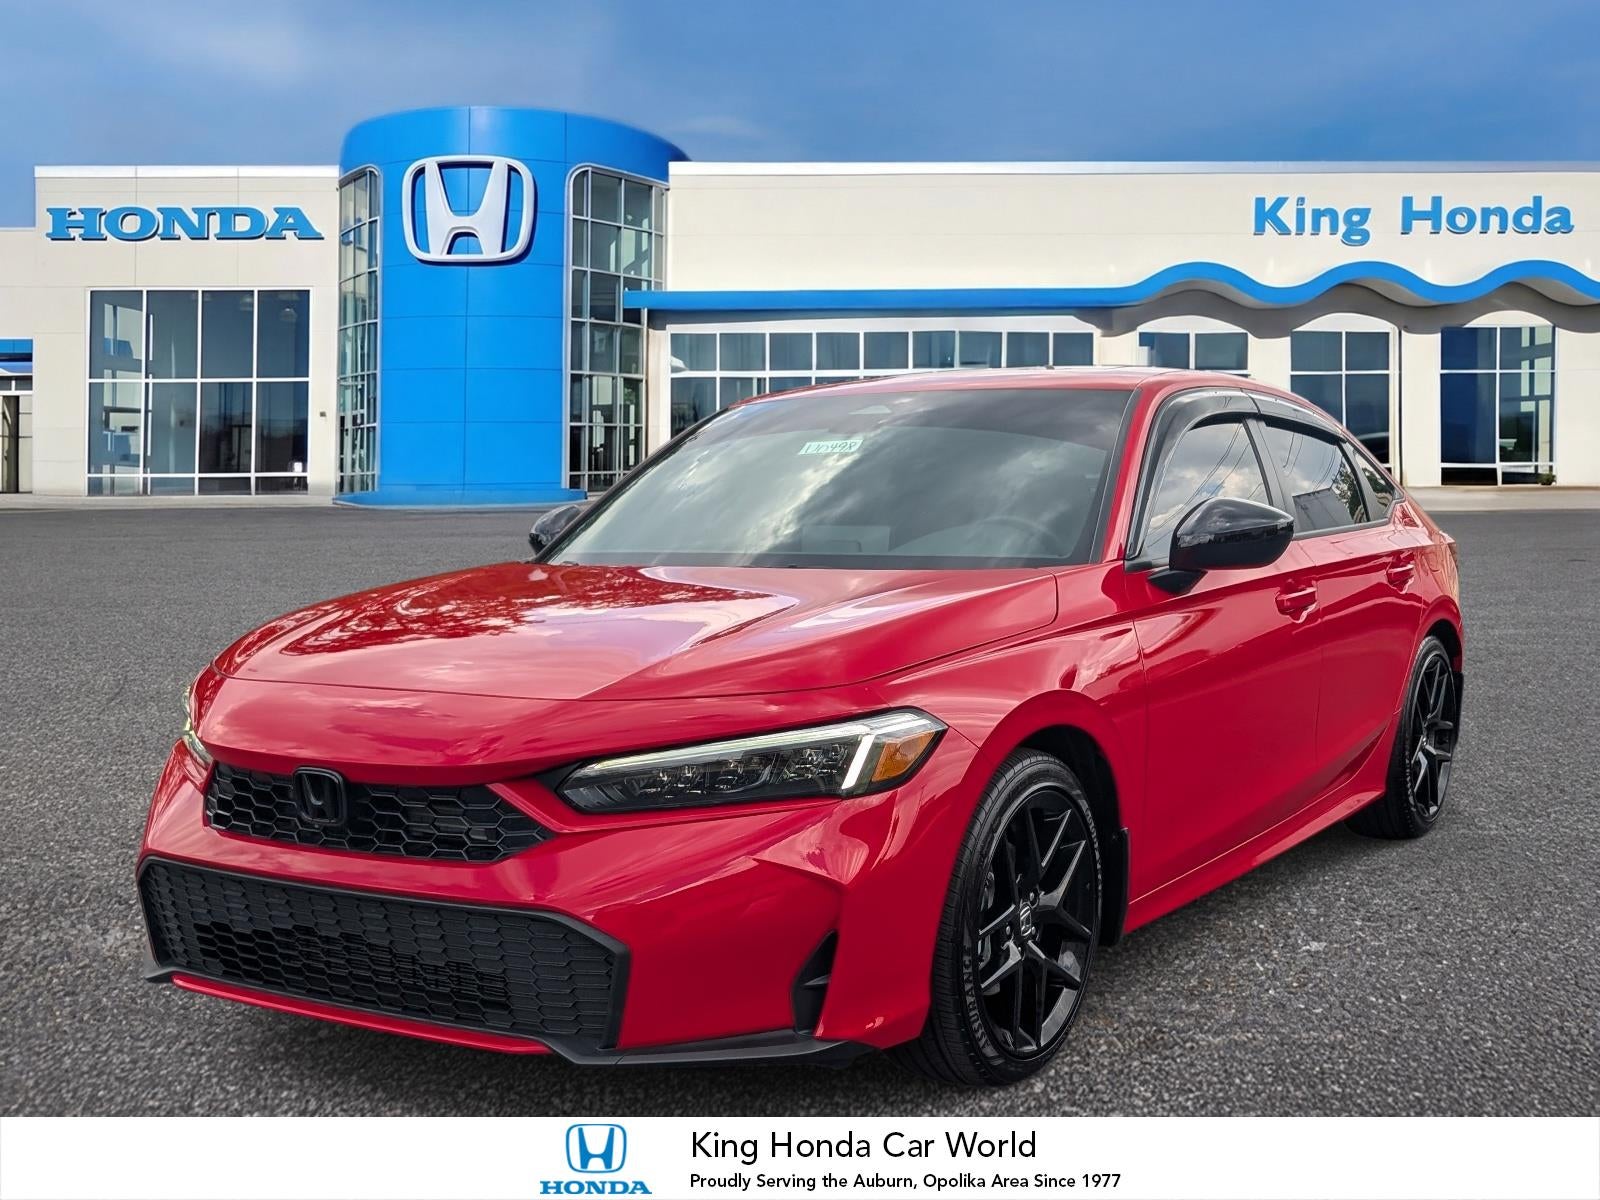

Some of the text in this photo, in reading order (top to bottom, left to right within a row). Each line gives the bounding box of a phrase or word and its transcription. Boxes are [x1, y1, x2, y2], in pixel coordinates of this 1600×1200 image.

[46, 206, 324, 242] HONDA
[1253, 195, 1575, 247] King Honda
